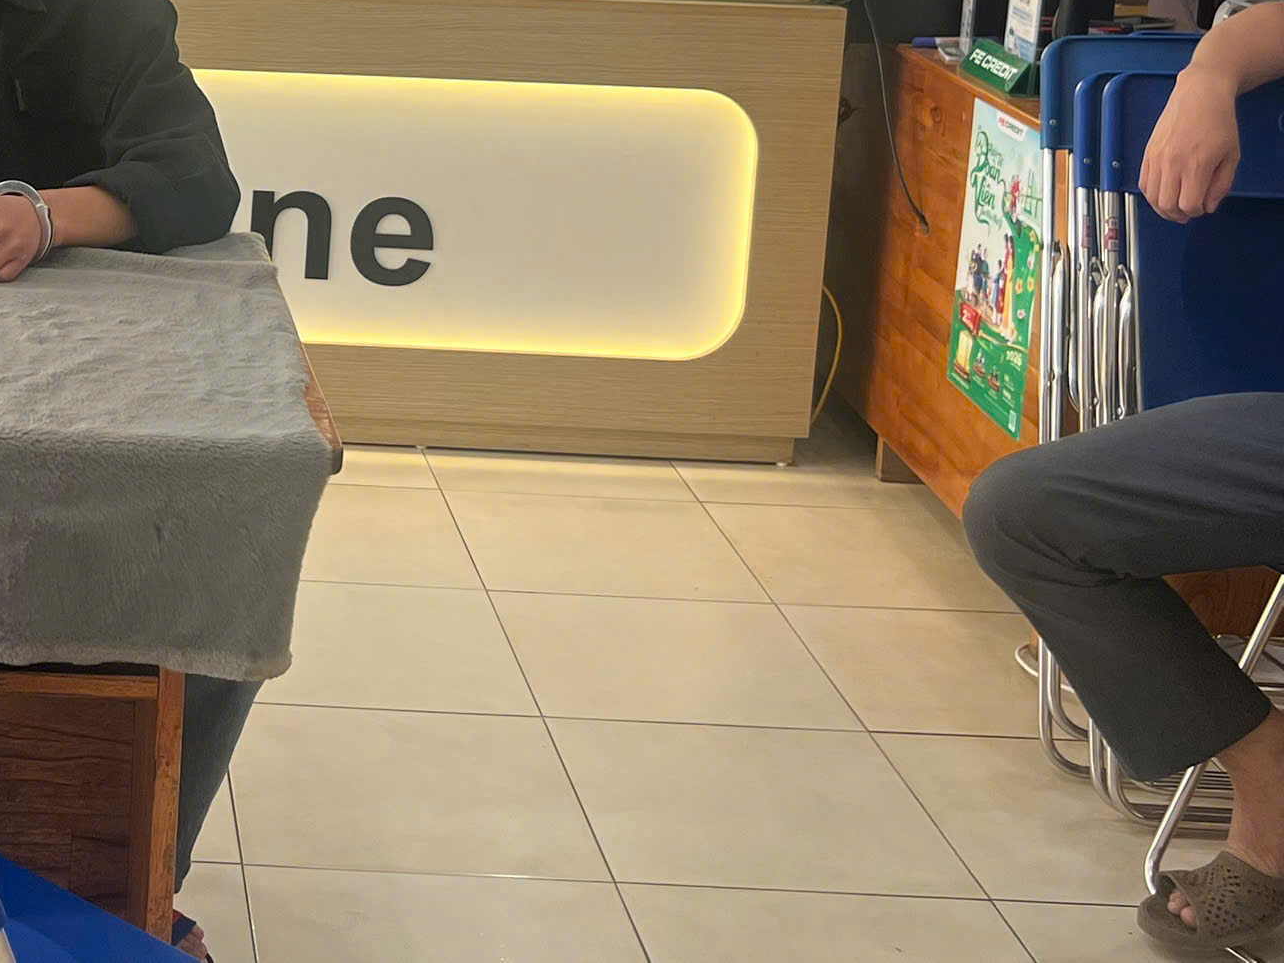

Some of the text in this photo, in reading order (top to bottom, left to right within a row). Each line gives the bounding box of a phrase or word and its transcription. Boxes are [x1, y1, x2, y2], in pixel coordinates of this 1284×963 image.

[969, 48, 1018, 81] FE CREDIT
[250, 189, 434, 287] ne
